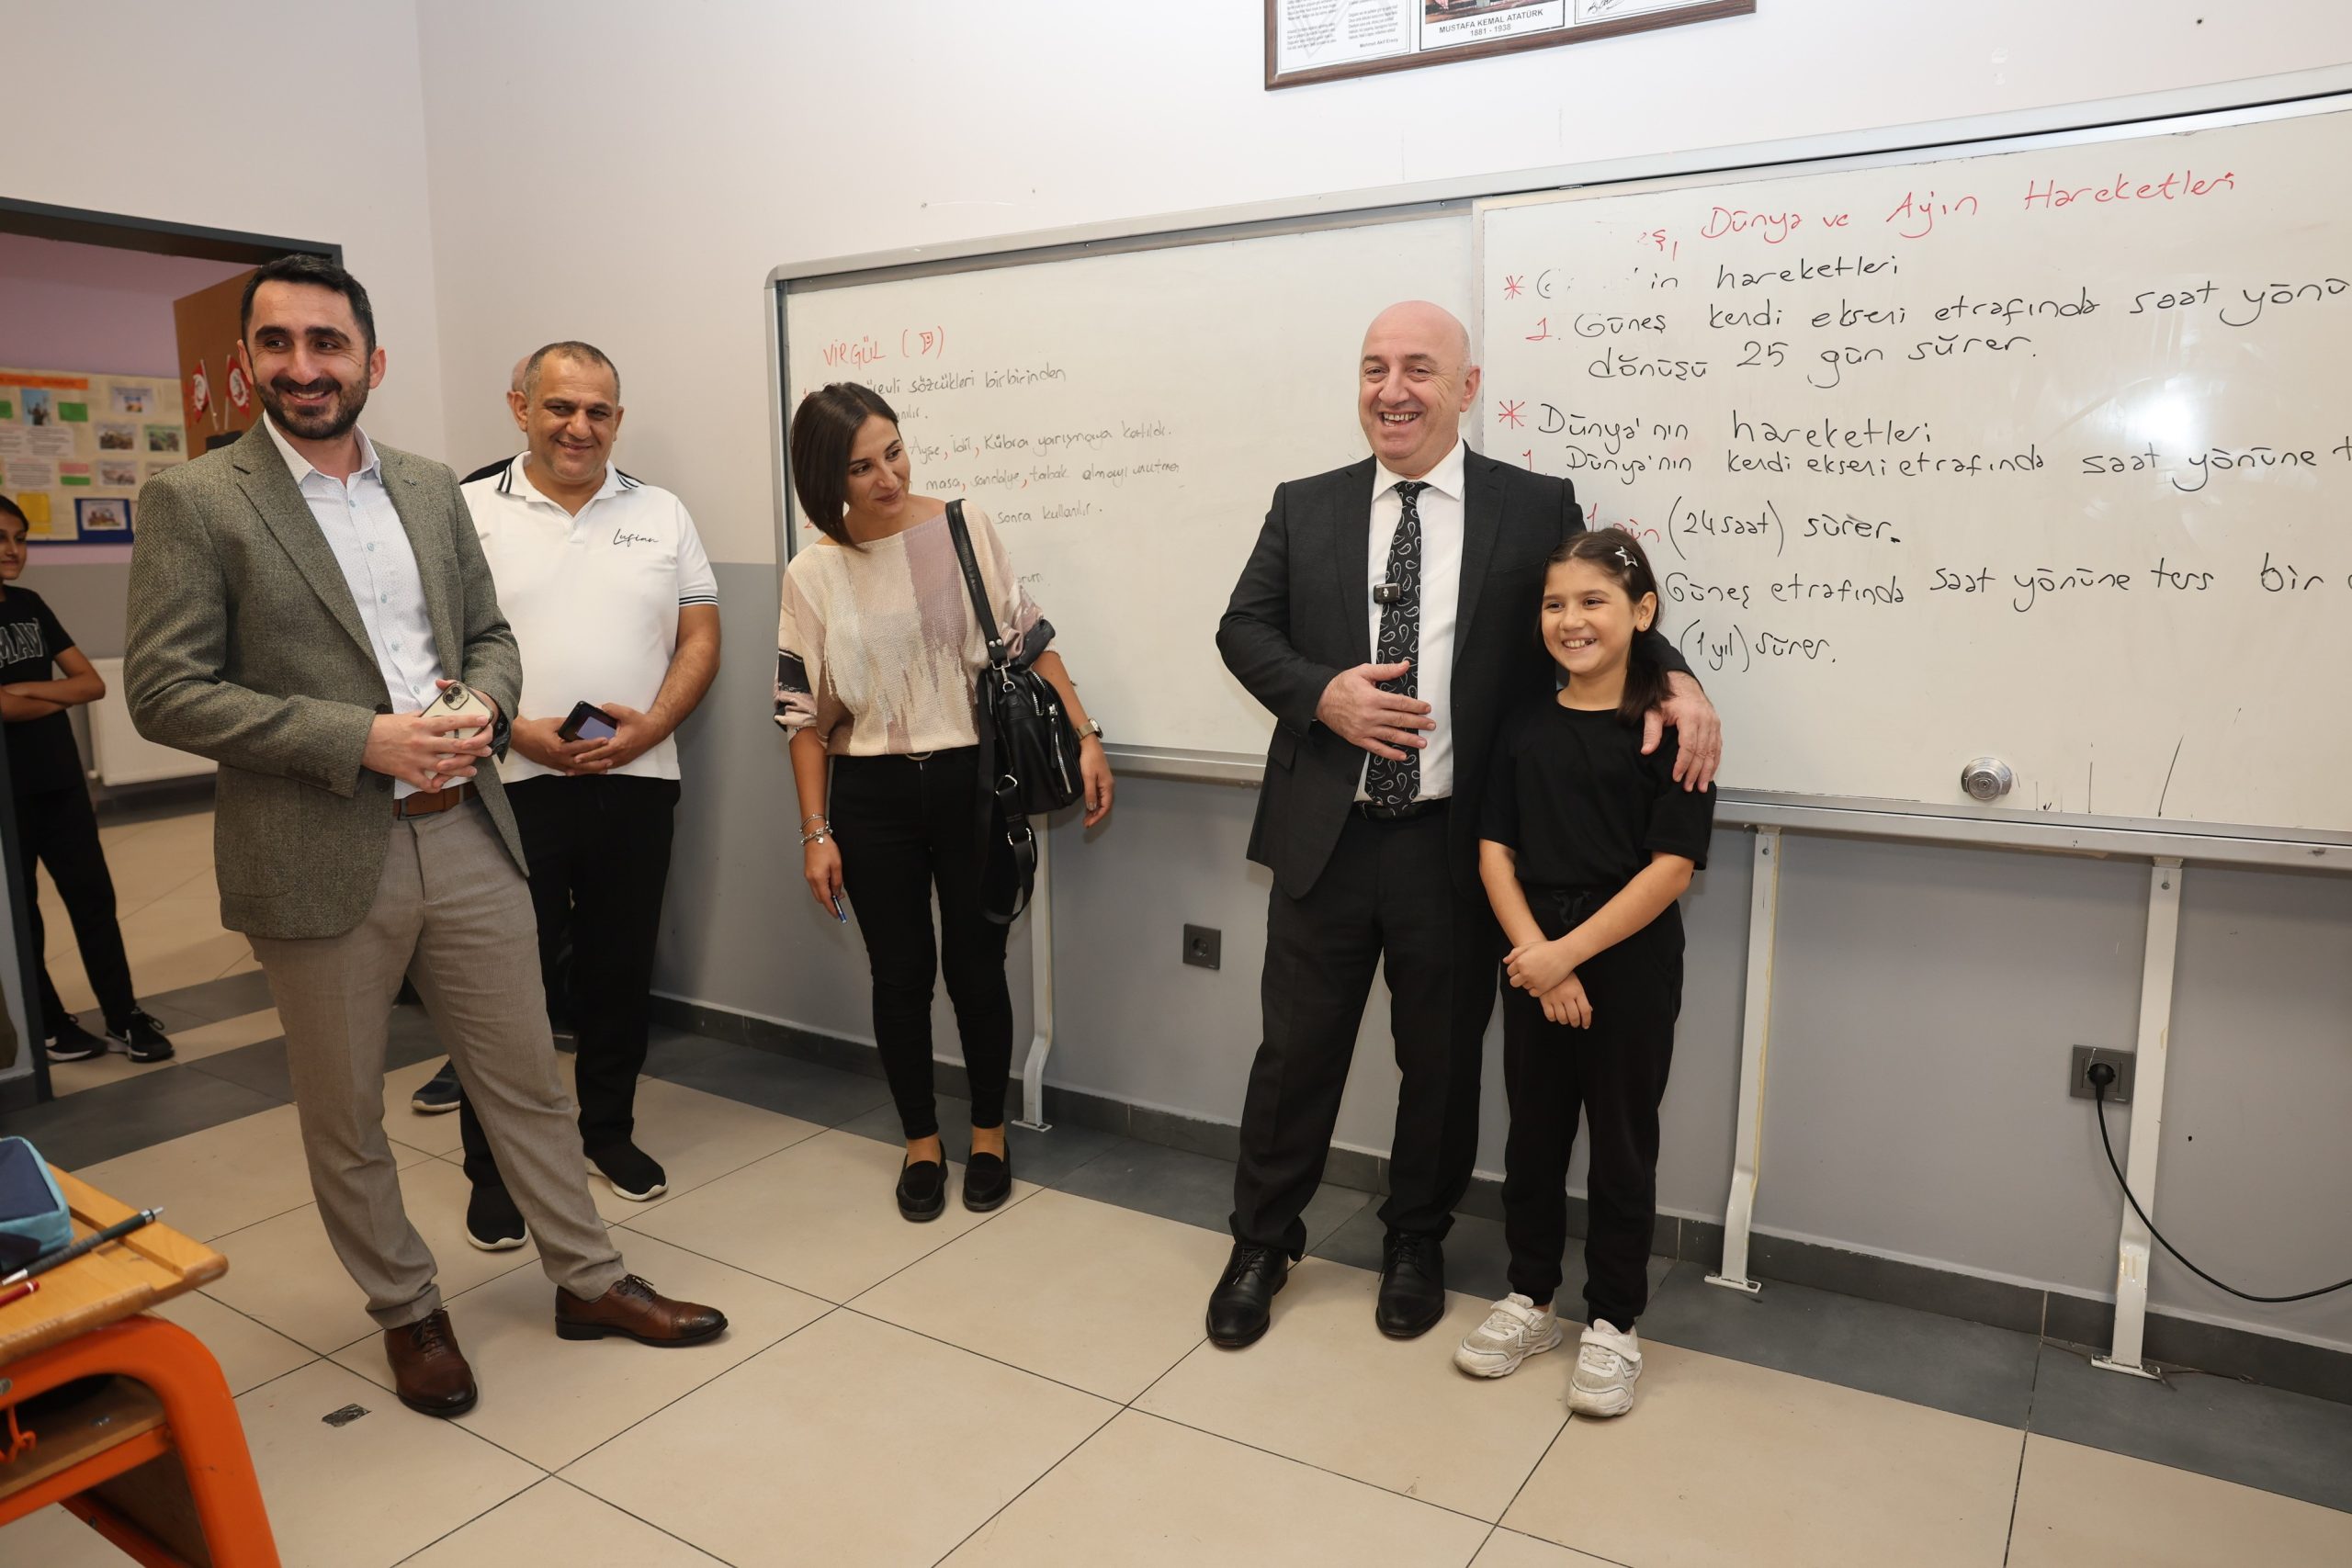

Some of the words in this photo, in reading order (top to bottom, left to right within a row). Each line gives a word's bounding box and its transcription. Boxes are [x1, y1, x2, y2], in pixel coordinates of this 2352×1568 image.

[1439, 21, 1476, 33] MUSTAFA
[1477, 17, 1505, 27] KEMAL
[1507, 8, 1544, 21] ATATÜRK
[1470, 28, 1487, 37] 1881
[1495, 24, 1511, 33] 1938
[1701, 207, 1803, 243] Dünya
[1823, 213, 1849, 228] ve
[2024, 170, 2234, 211] Hareketleri
[1716, 255, 1898, 290] hareketleri
[1574, 313, 1667, 338] Güneş
[1934, 287, 2101, 326] etrafında
[2129, 280, 2220, 314] saat
[822, 335, 887, 370] VİRGÜL
[1588, 347, 1709, 380] dönüşü
[1736, 341, 1789, 368] 25
[1806, 348, 1883, 389] gün
[1908, 333, 2037, 360] sürer.
[908, 369, 975, 393] sözcükleri
[985, 361, 1067, 389] birbirinden
[984, 433, 1029, 450] Kübra
[1733, 409, 1931, 448] hareketleri
[1029, 463, 1071, 481] tabak
[1899, 445, 2044, 477] etrafında
[2082, 442, 2161, 474] saat
[2172, 446, 2317, 491] yönüne
[1804, 513, 1901, 544] sürer.
[1665, 571, 1749, 609] Güneş
[1770, 573, 1905, 604] etrafında
[1930, 566, 1996, 593] saat
[2013, 568, 2132, 613] yönüne
[2151, 557, 2214, 591] ters
[2260, 552, 2324, 592] bir
